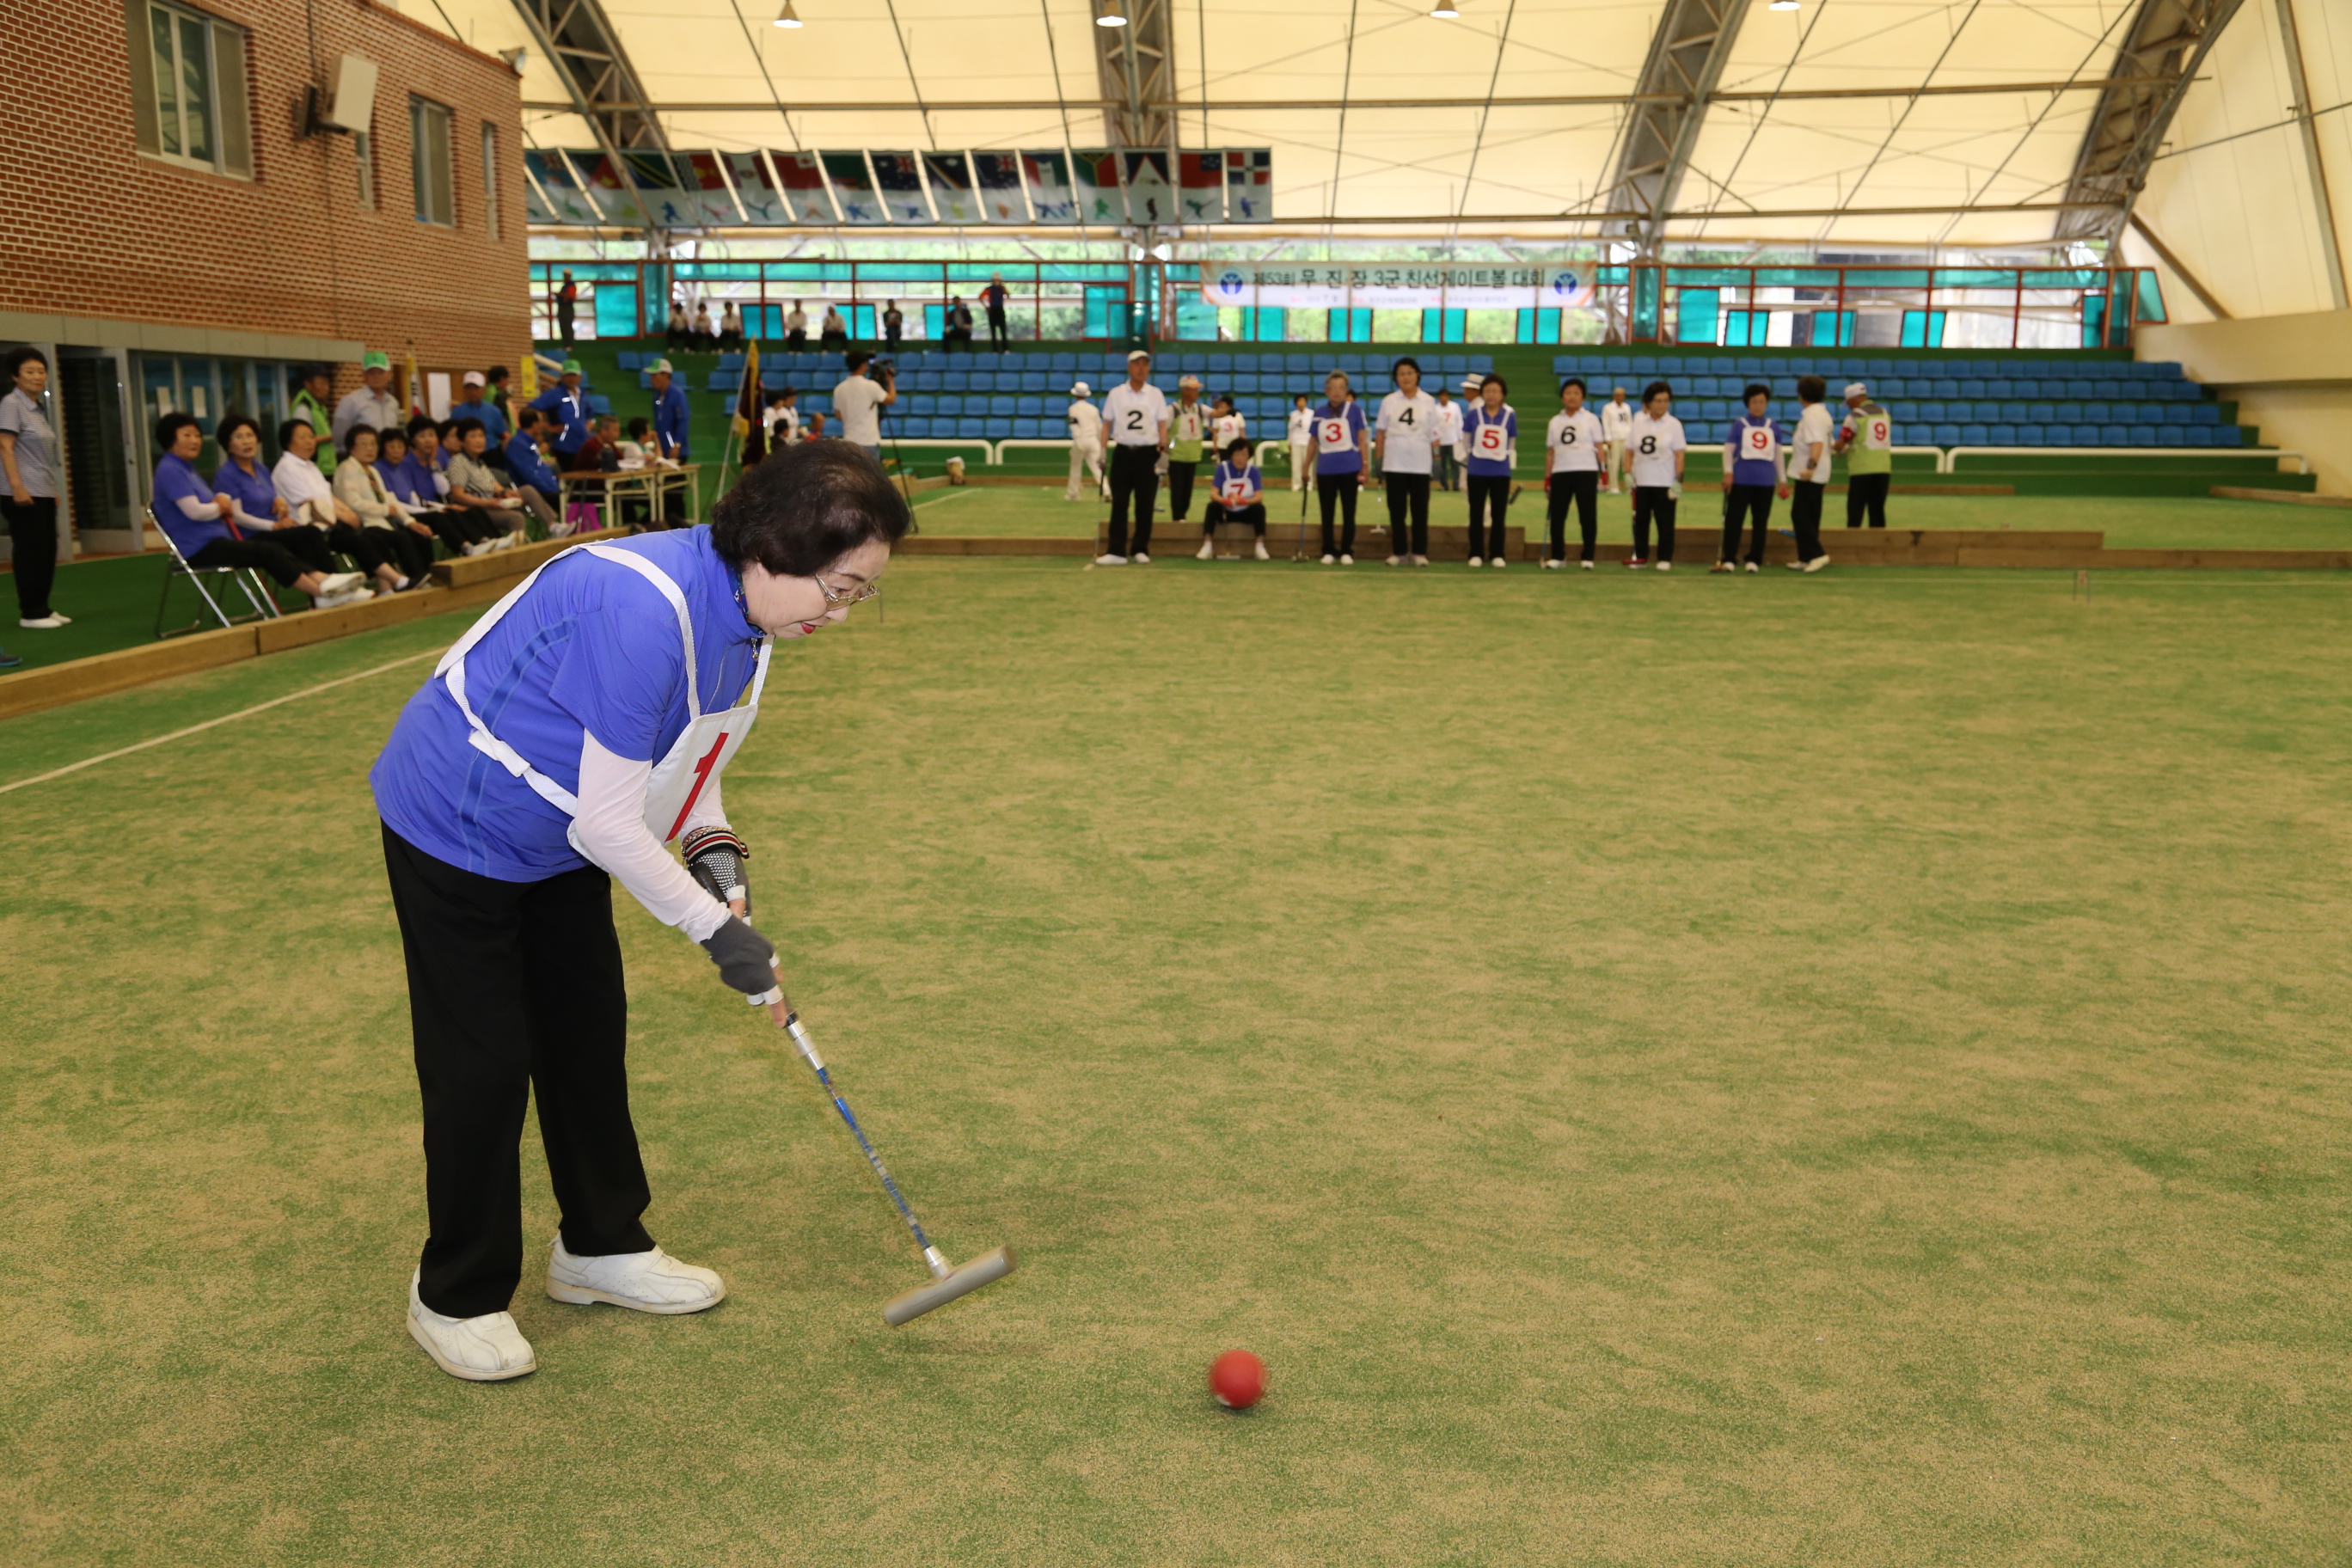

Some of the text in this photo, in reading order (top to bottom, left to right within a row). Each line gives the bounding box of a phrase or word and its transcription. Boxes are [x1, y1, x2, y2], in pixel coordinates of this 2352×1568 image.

[1253, 271, 1295, 286] 제53회
[1374, 269, 1400, 289] 3군
[1512, 268, 1545, 288] 대회
[1127, 410, 1143, 430] 2
[1188, 418, 1195, 433] 1
[1399, 407, 1415, 426] 4
[1325, 423, 1343, 443] 3
[1482, 430, 1500, 449] 5
[1560, 426, 1576, 444] 6
[1751, 431, 1768, 450] 9
[1873, 422, 1887, 441] 9
[1640, 436, 1657, 454] 8
[1230, 483, 1245, 495] 7
[665, 732, 729, 842] 1
